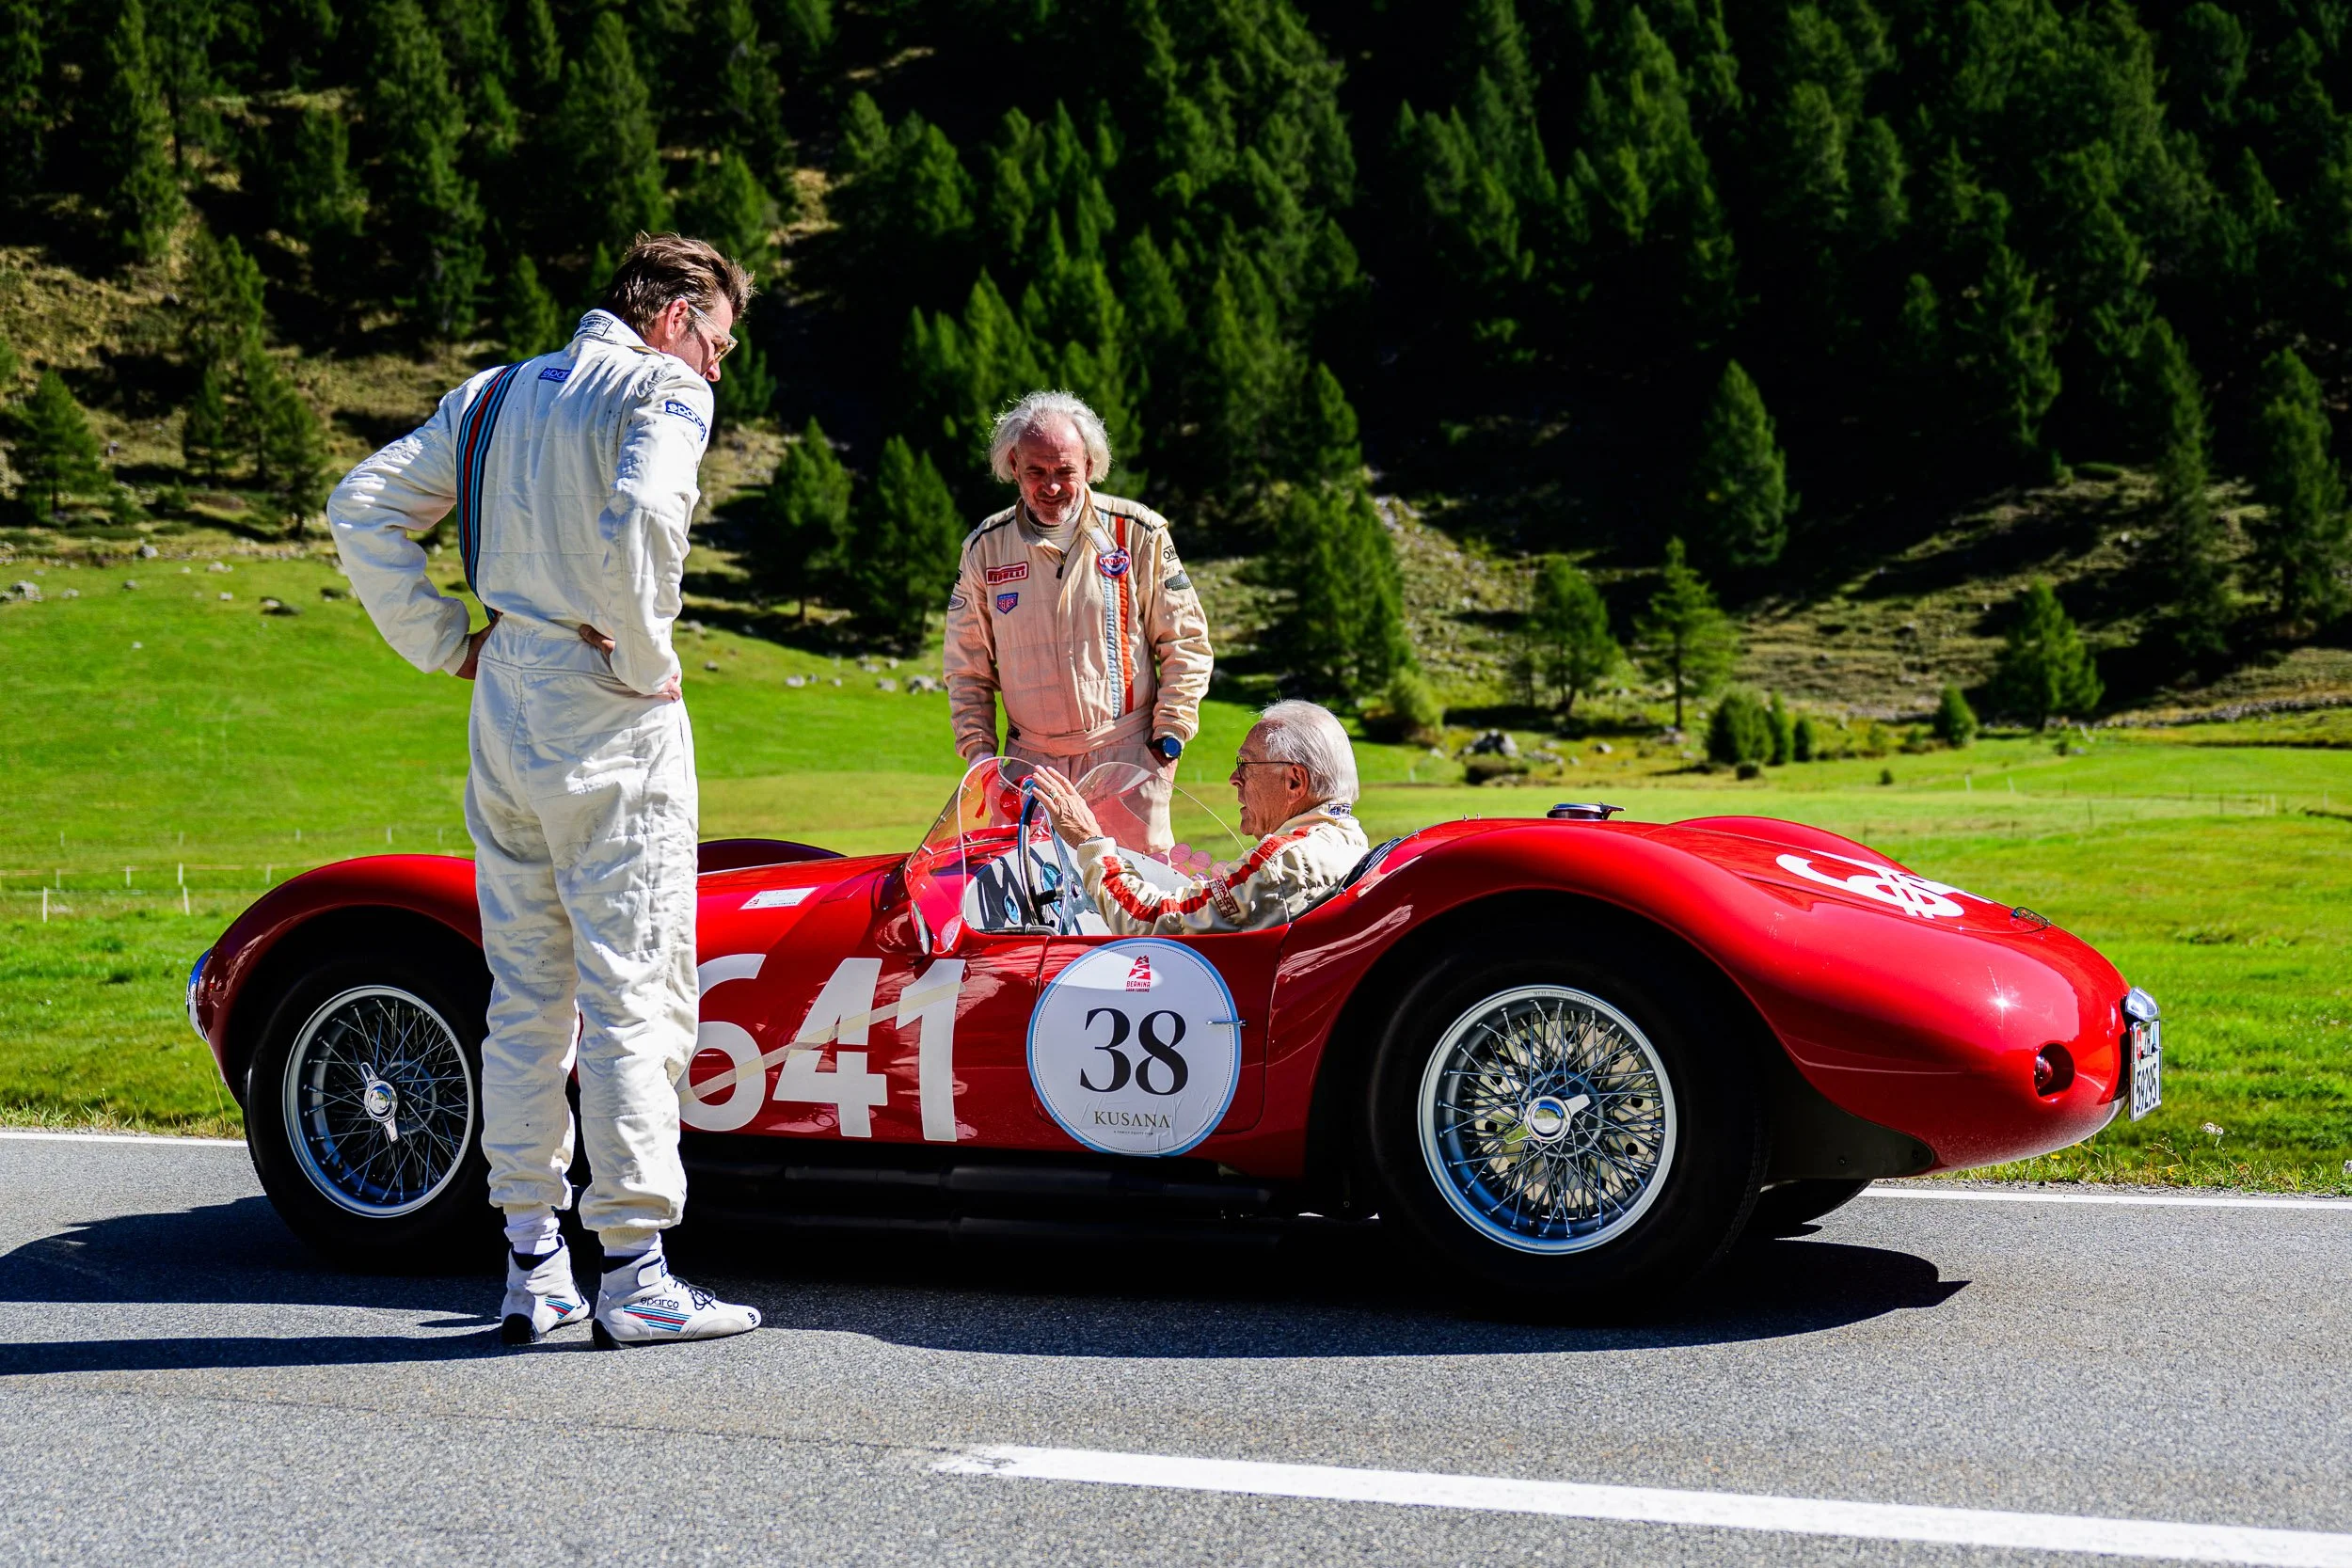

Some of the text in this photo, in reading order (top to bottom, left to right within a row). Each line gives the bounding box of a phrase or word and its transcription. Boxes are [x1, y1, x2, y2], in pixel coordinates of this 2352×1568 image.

[1101, 557, 1127, 565] VOLVO
[987, 565, 1025, 583] PIRELLI
[679, 954, 966, 1142] 641
[1080, 1007, 1189, 1096] 38
[1094, 1111, 1170, 1128] KUSANA
[640, 1297, 679, 1310] sparco
